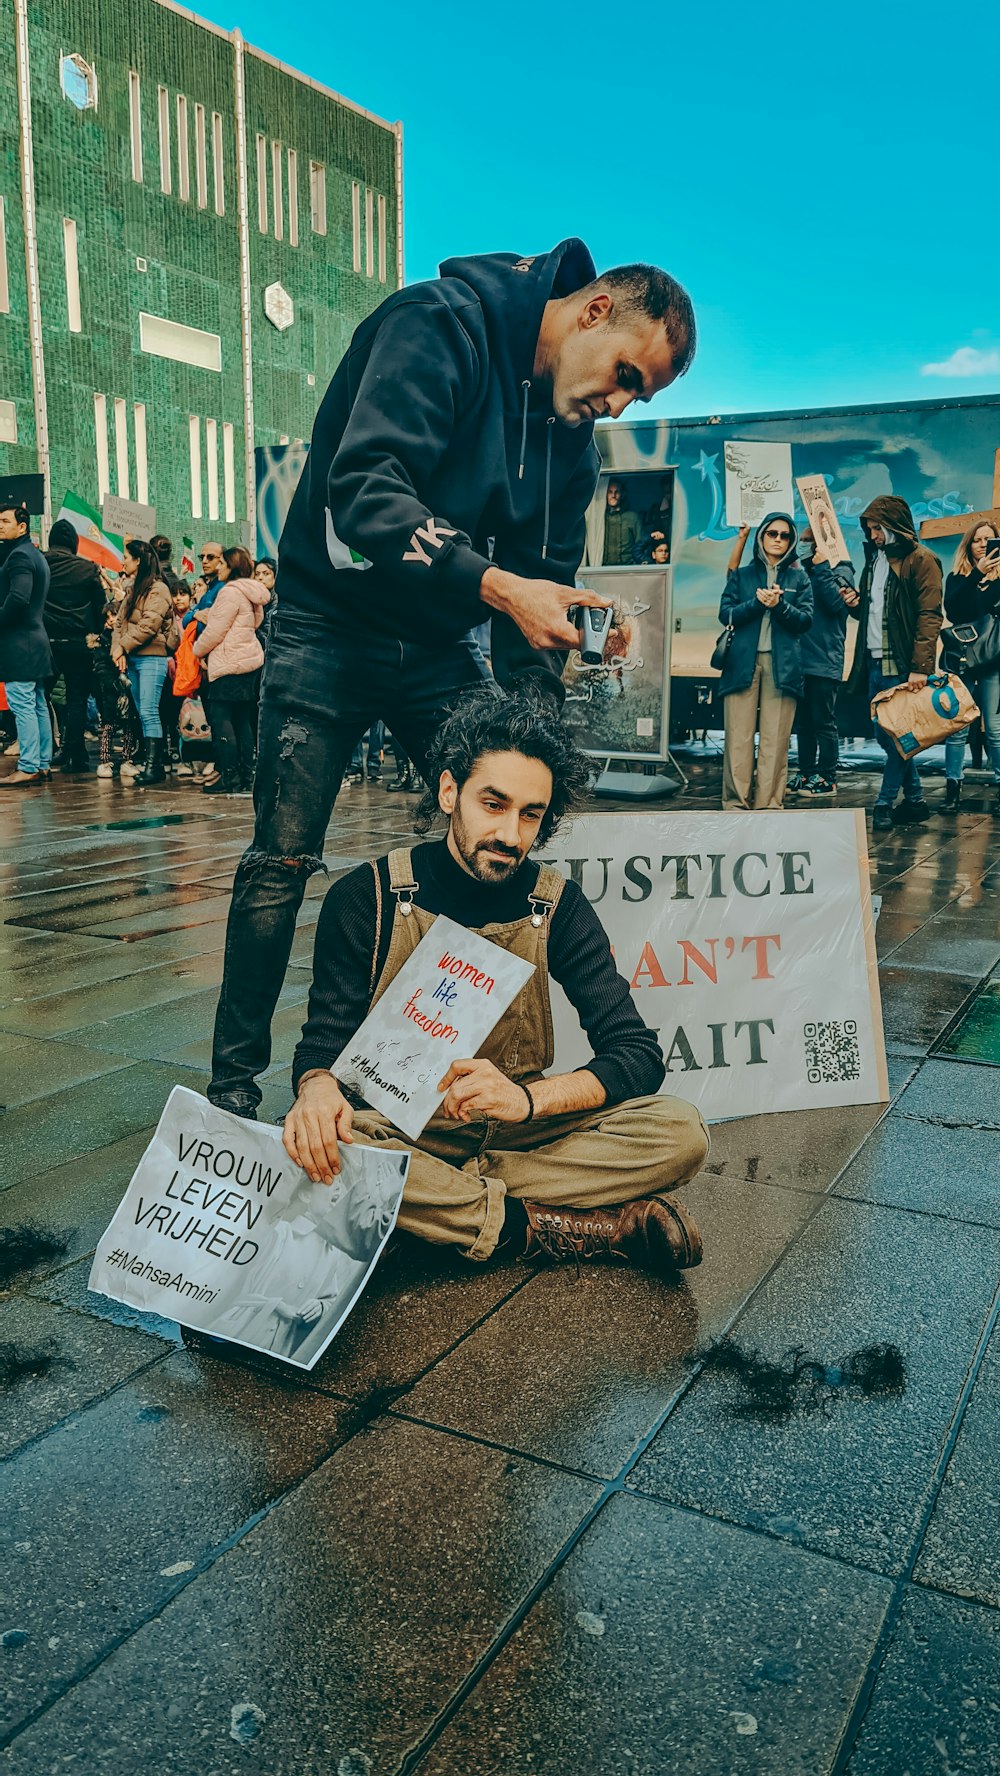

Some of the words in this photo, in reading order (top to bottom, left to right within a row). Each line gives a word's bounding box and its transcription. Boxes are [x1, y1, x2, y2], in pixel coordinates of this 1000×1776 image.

[402, 517, 458, 567] YK
[536, 851, 814, 905] USTICE
[437, 951, 495, 996] women
[611, 935, 781, 989] AN'T
[402, 988, 459, 1045] freedom
[431, 978, 458, 1008] life
[654, 1018, 775, 1073] AIT
[177, 1132, 283, 1198] VROUW
[165, 1170, 264, 1230] LEVEN
[134, 1197, 259, 1267] VRIJHEID
[106, 1248, 221, 1305] #MahsaAmini
